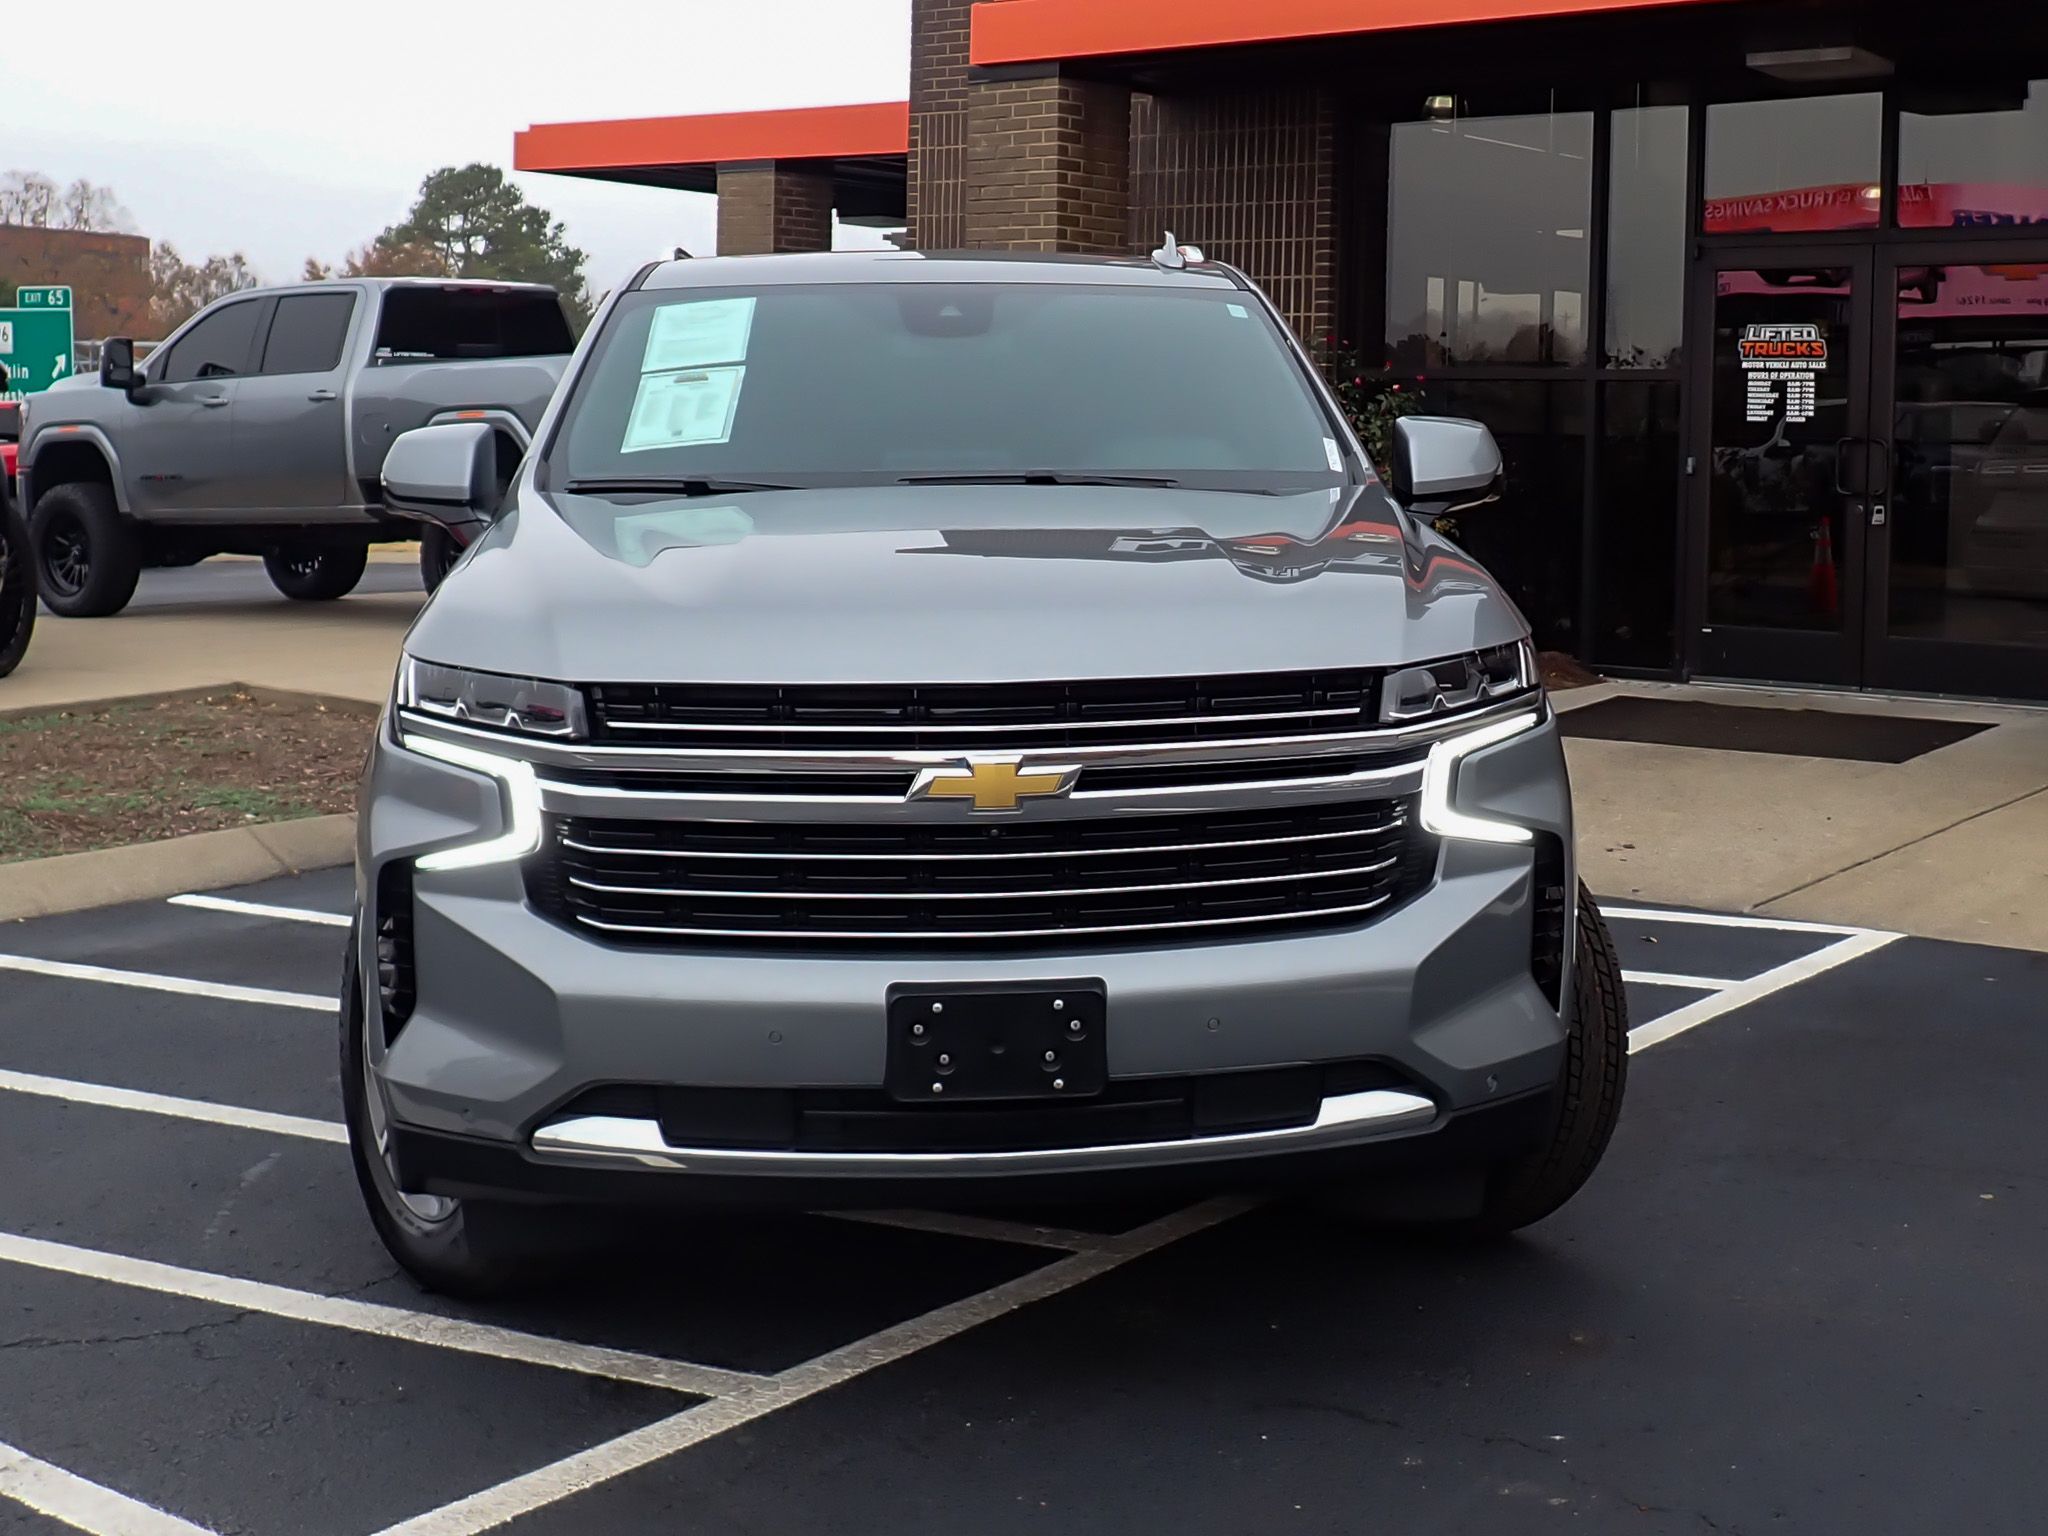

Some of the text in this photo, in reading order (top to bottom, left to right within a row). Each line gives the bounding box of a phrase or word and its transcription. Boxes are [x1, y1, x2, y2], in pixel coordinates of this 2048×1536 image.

[25, 289, 64, 305] EXIT 65
[1747, 327, 1816, 341] LIFTED
[1742, 342, 1824, 356] TRUCKS
